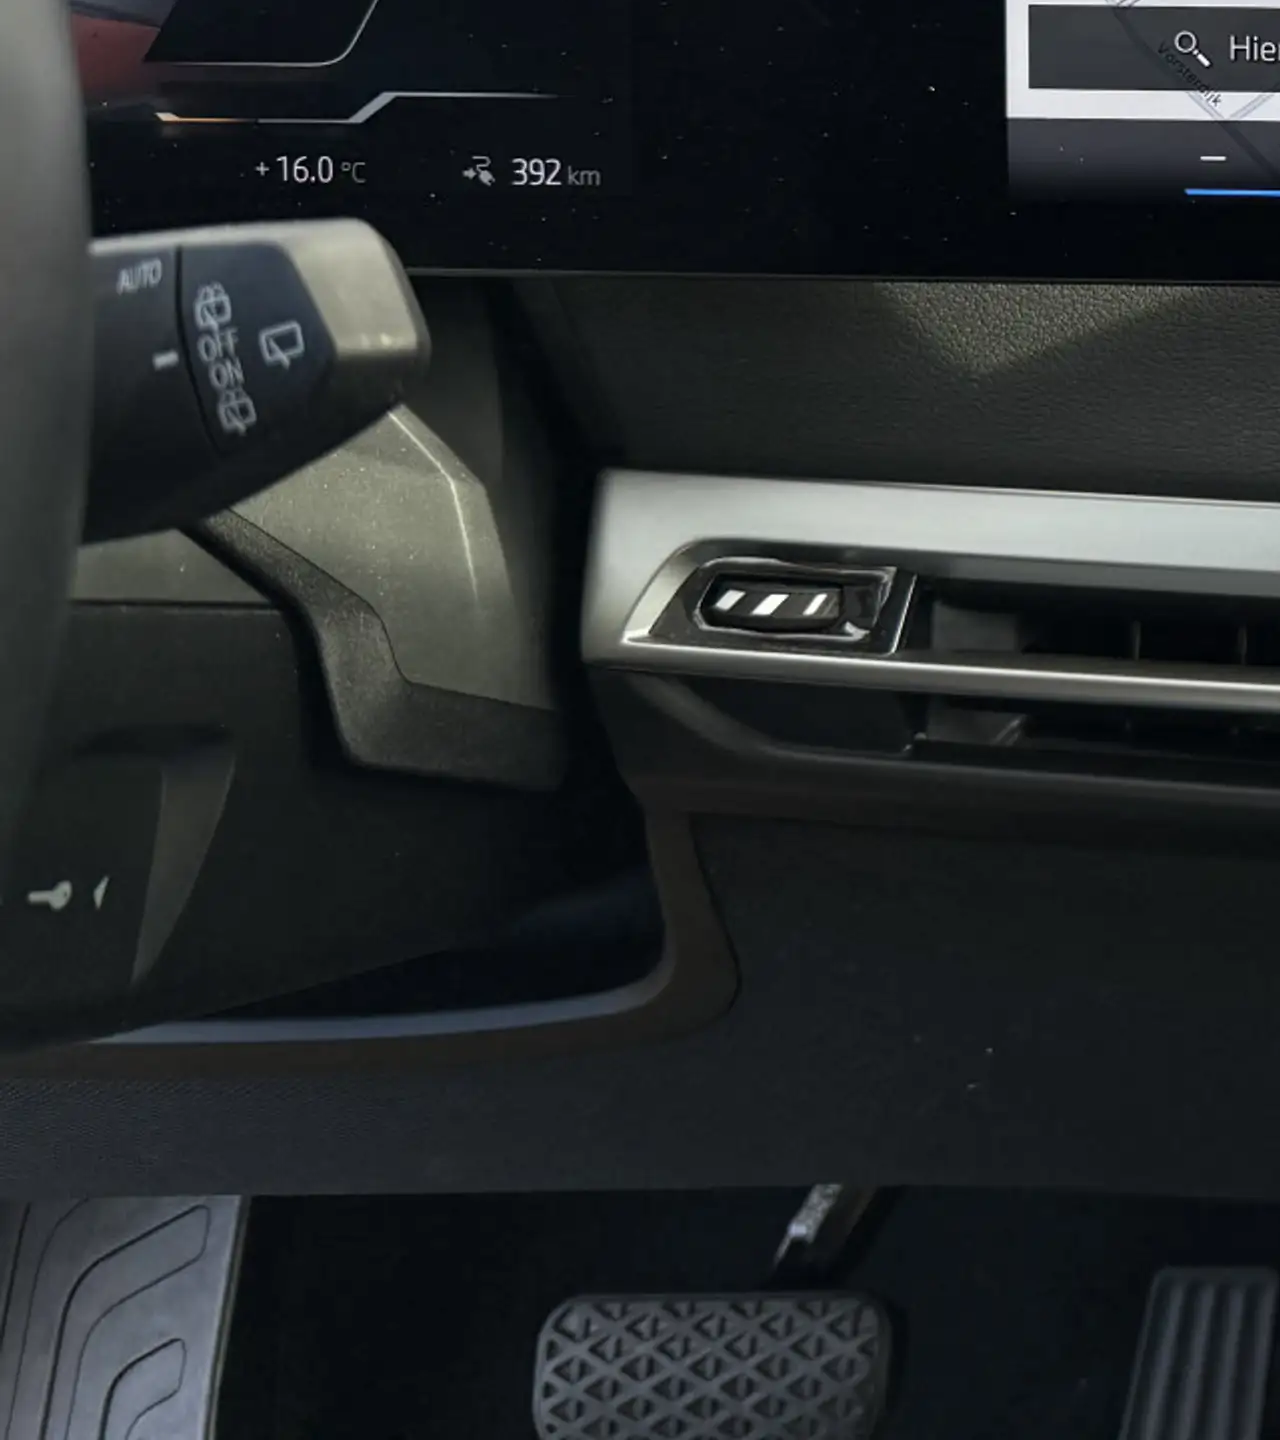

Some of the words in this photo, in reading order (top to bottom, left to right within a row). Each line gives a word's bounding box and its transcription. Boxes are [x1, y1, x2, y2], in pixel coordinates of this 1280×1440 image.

[511, 158, 563, 187] 392
[566, 166, 602, 187] km
[116, 258, 162, 295] AUTO
[198, 327, 239, 362] OFF
